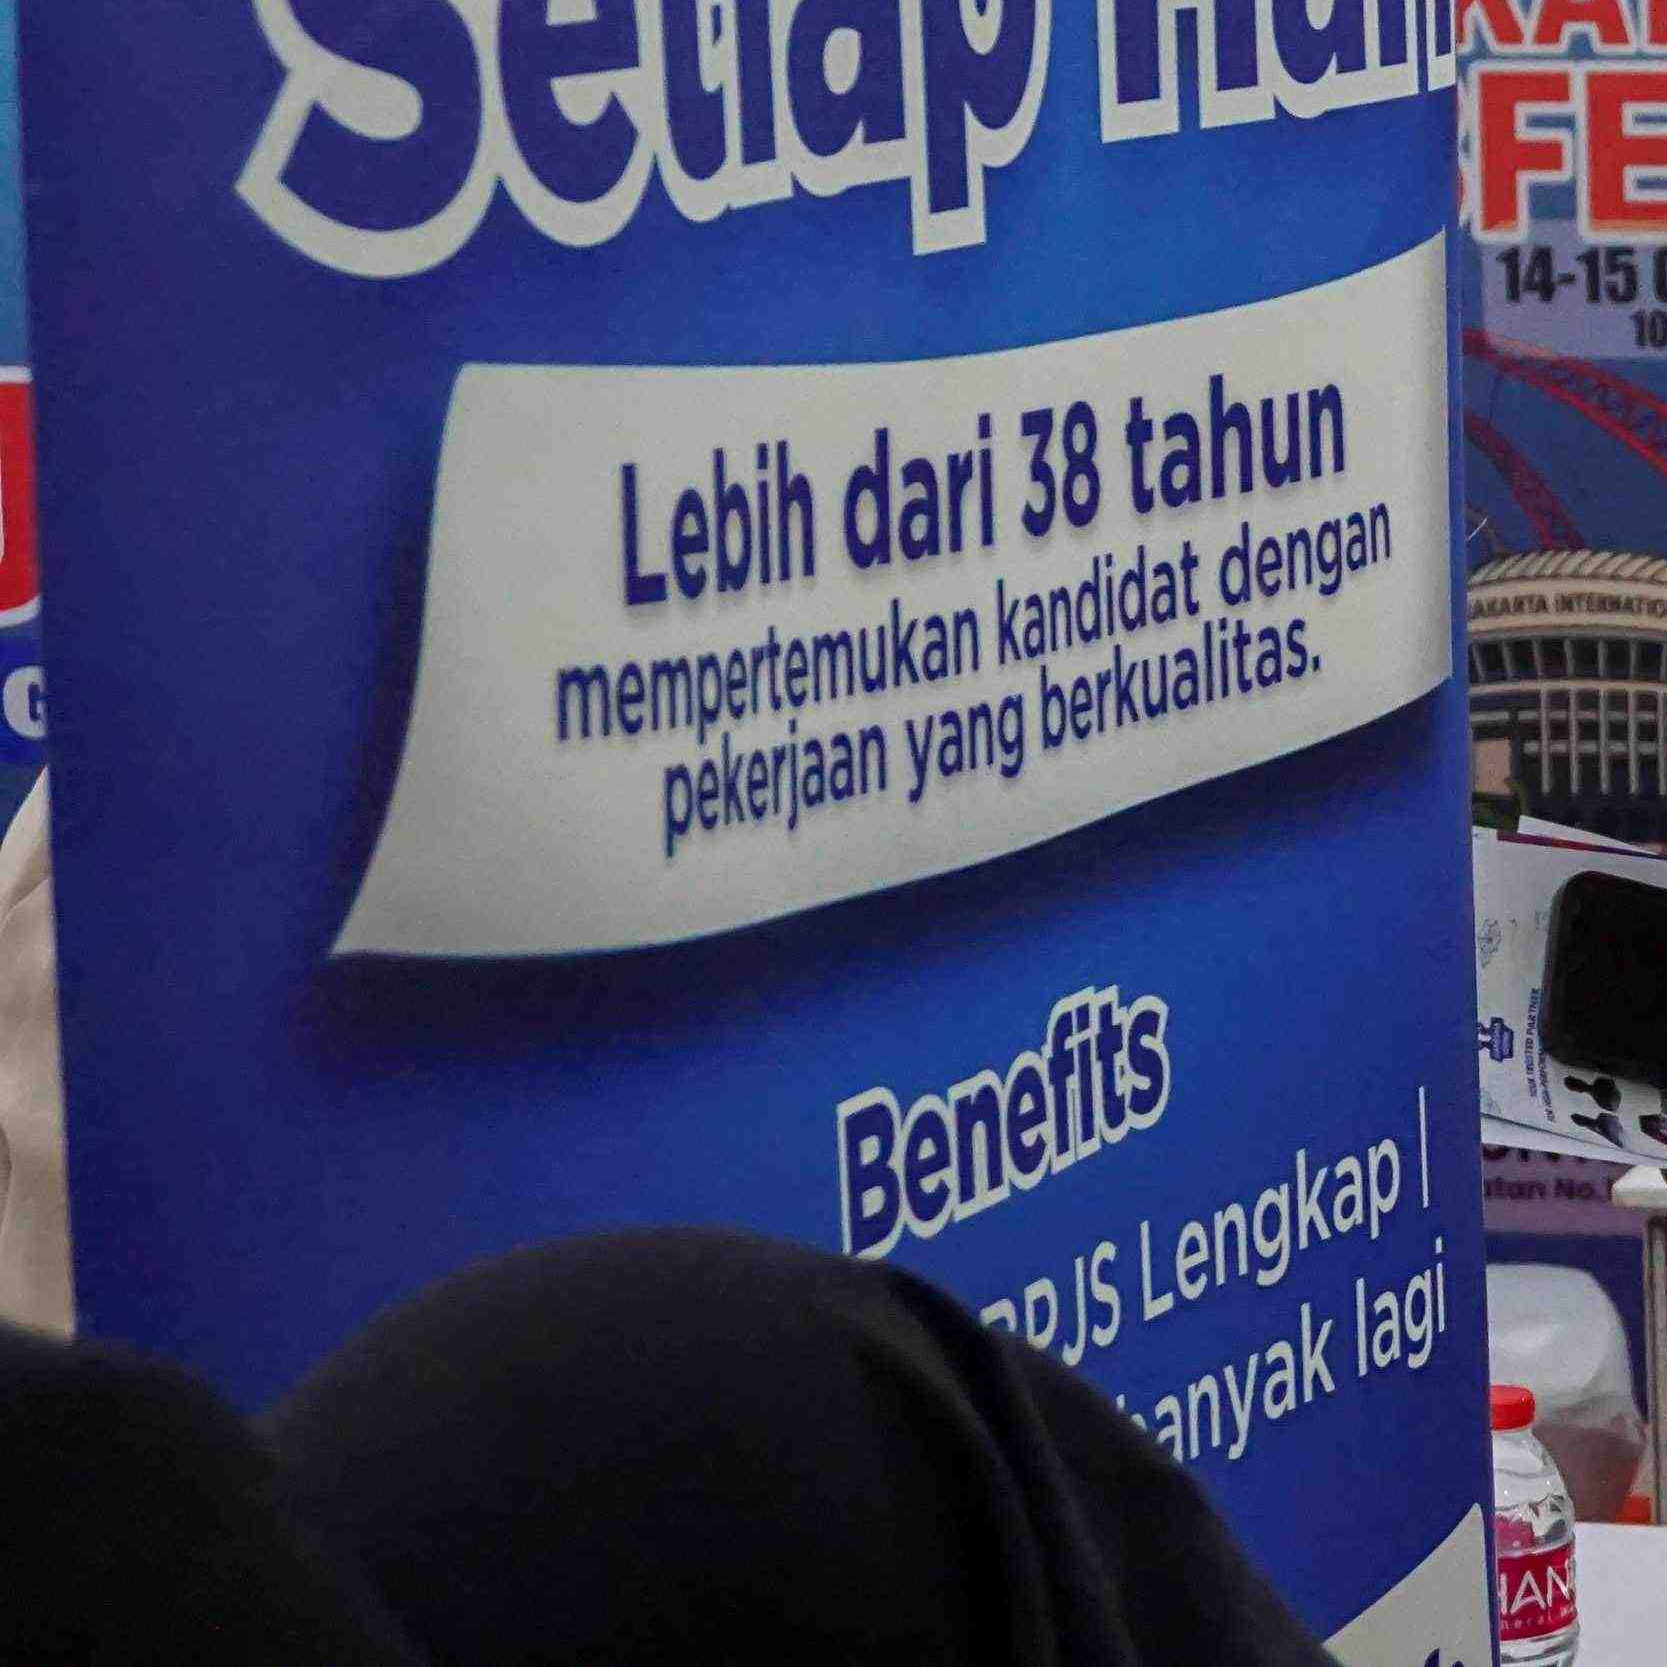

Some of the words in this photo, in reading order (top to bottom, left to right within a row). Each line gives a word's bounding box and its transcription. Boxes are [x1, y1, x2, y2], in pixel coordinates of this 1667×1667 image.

[1495, 245, 1638, 304] 14-15
[619, 439, 816, 606] Lebih
[843, 412, 994, 570] dari
[1020, 400, 1101, 536] 38
[1125, 372, 1345, 514] tahun
[556, 597, 980, 745] mempertemukan
[996, 540, 1200, 665] kandidat
[1218, 501, 1391, 607] dengan
[662, 717, 887, 858] pekerjaan
[904, 693, 1025, 803] yang
[1040, 617, 1320, 750] berkualitas.
[837, 984, 1171, 1261] Benefits
[1139, 1137, 1401, 1323] Lengkap
[1355, 1235, 1446, 1378] lagi
